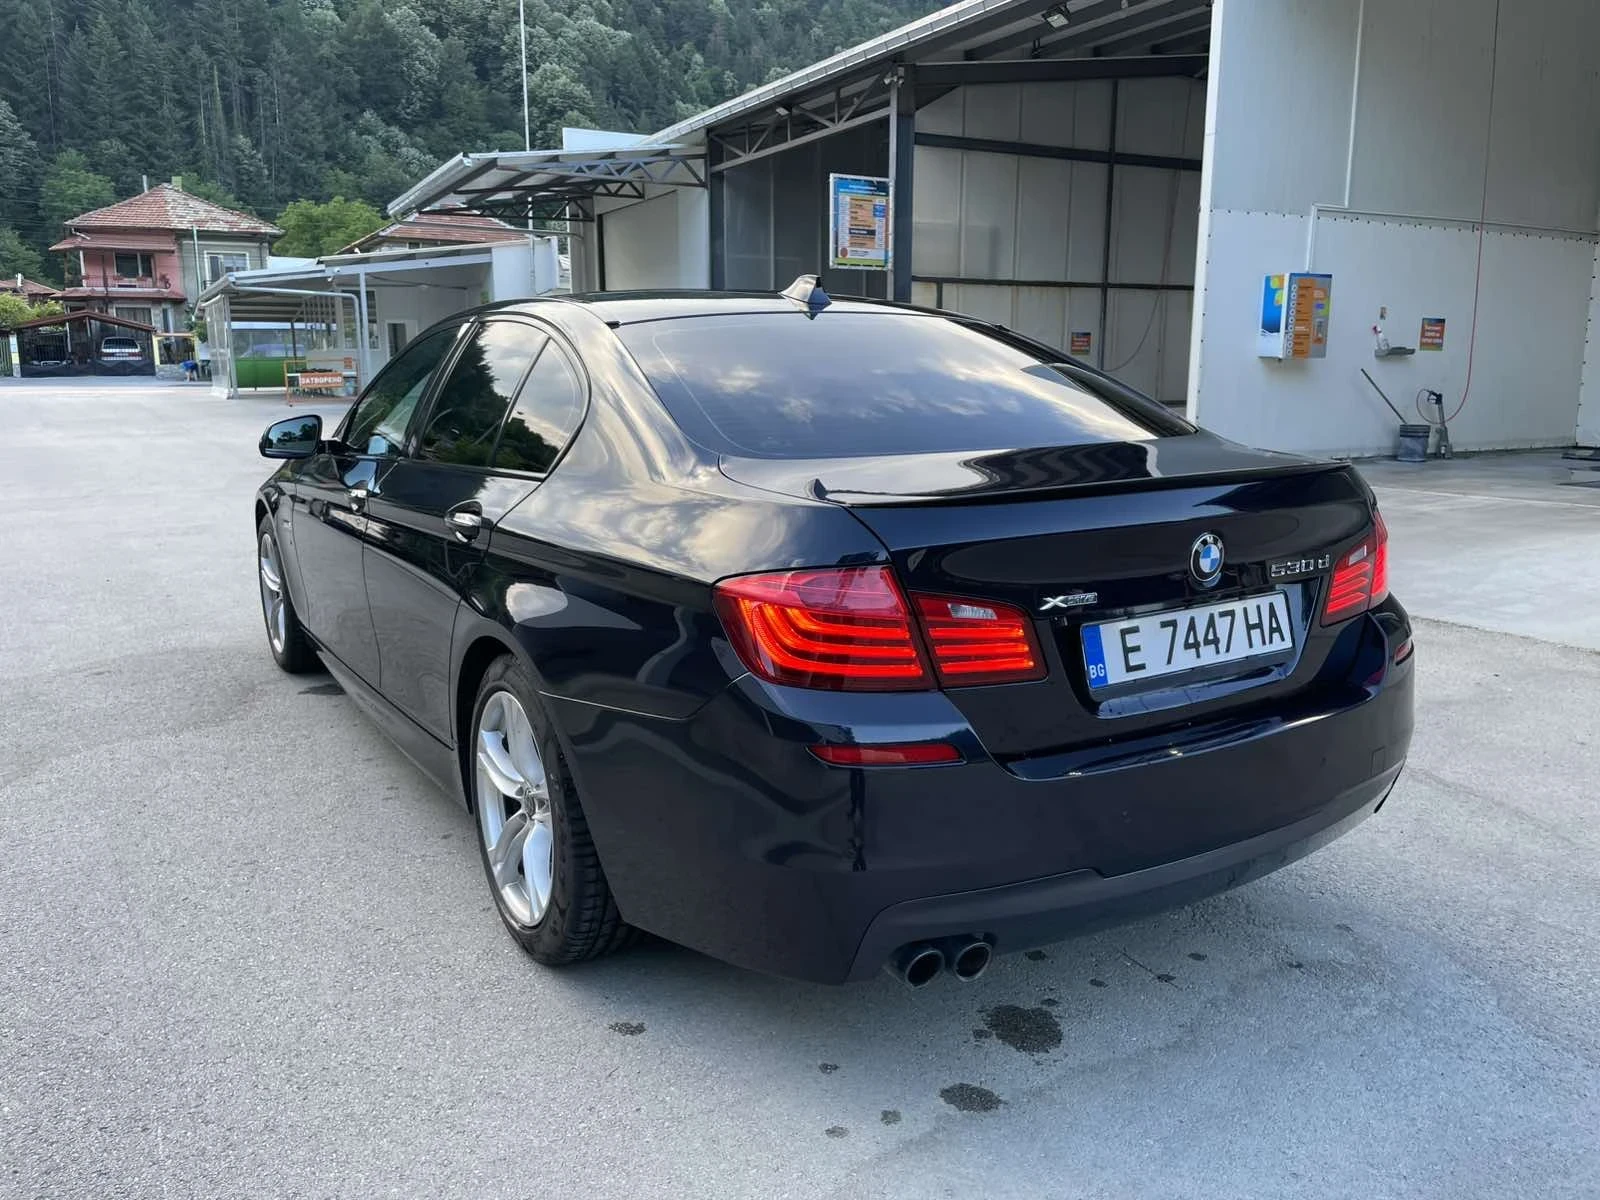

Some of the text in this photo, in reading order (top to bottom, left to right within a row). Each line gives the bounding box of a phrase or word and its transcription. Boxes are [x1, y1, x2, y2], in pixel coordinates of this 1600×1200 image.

[1119, 602, 1285, 673] E 7447 HA
[1089, 663, 1105, 679] BG
